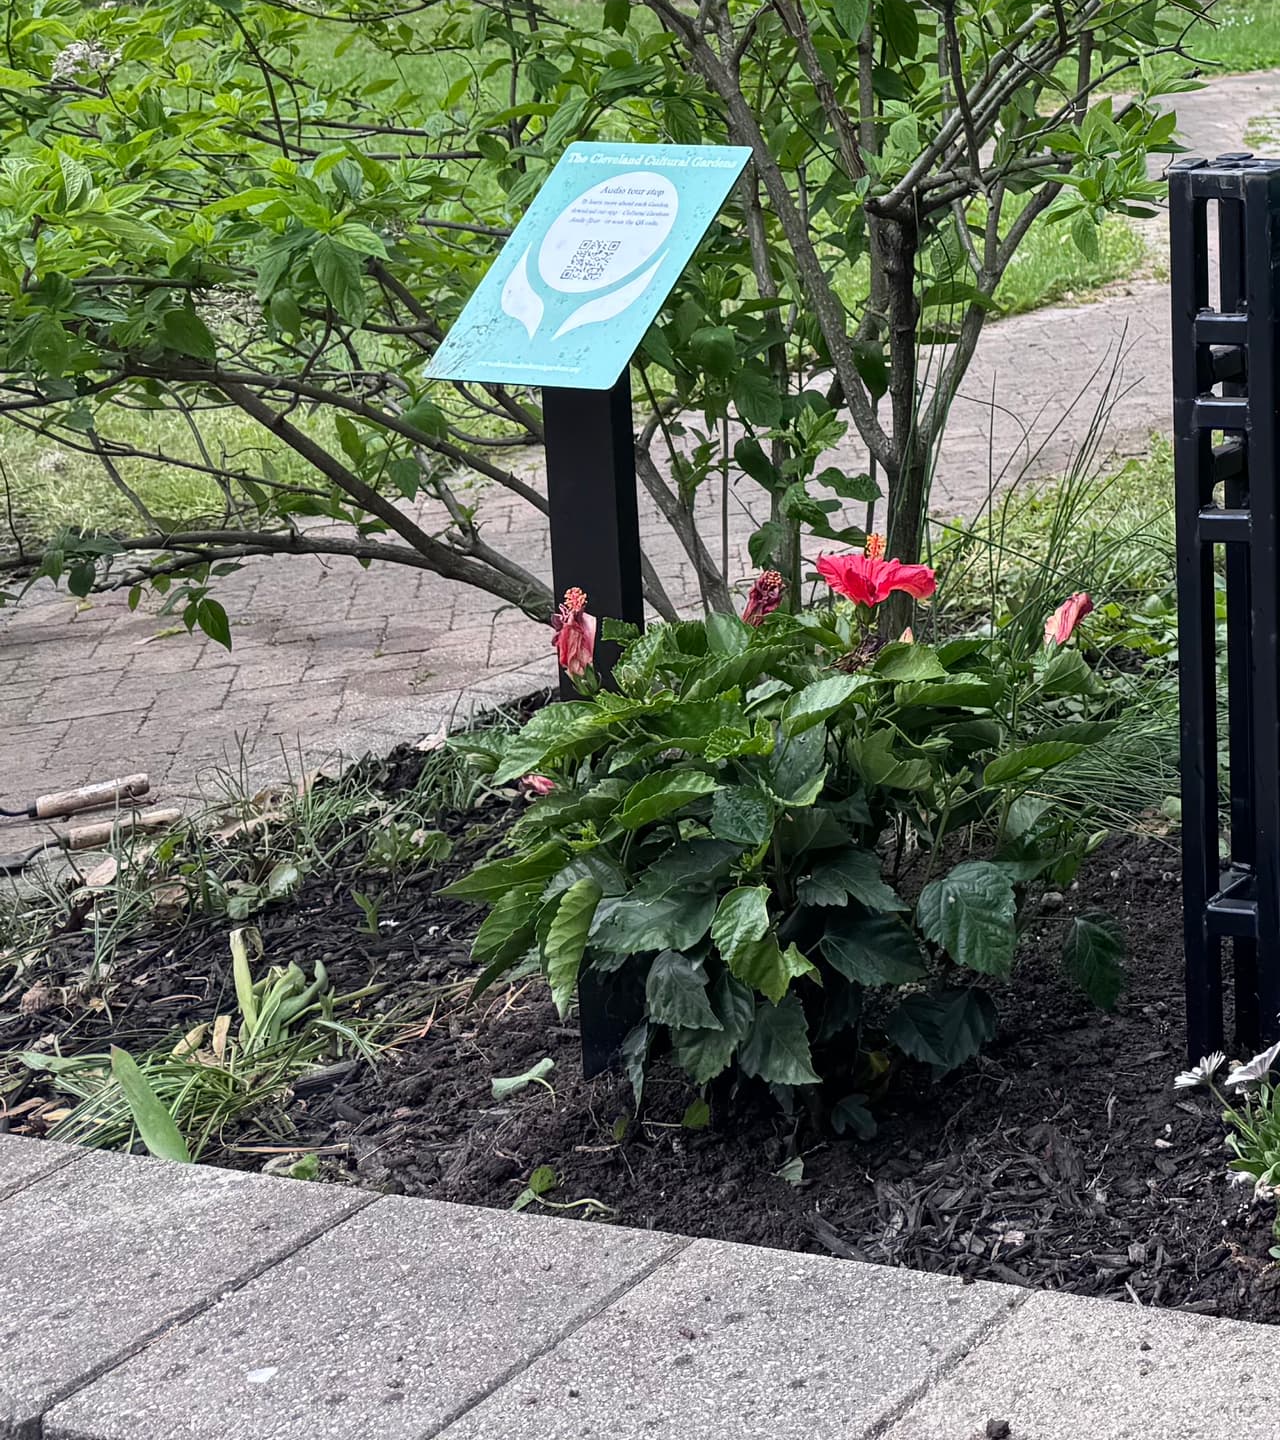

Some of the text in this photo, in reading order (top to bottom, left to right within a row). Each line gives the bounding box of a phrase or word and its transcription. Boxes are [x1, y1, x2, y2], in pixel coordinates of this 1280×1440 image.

[568, 152, 738, 169] The Cleveland Cultural Gardens
[600, 186, 665, 198] Audio tour stop
